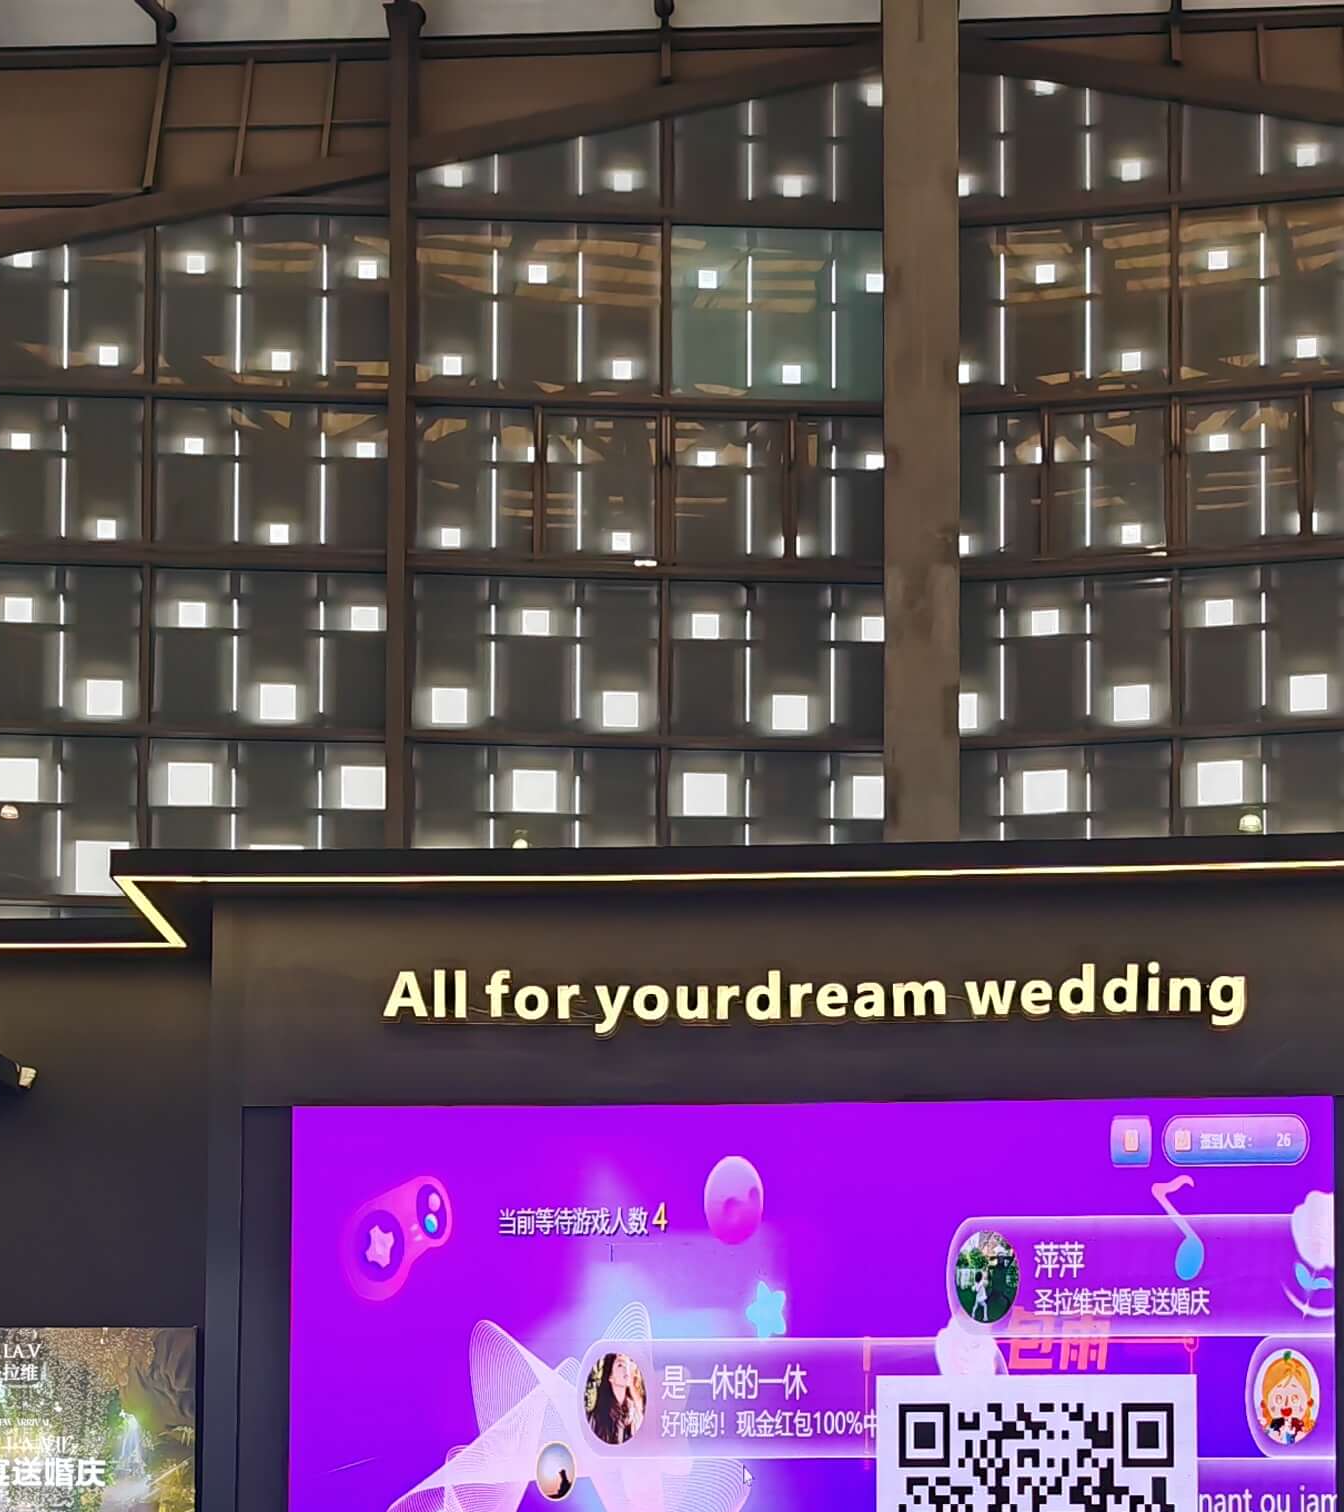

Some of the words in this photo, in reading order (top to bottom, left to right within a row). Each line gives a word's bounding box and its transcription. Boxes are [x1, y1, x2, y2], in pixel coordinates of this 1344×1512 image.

[383, 968, 467, 1018] All
[484, 969, 582, 1020] for
[965, 962, 1248, 1026] wedding
[1276, 1132, 1292, 1148] 26
[498, 1207, 649, 1235] 当前等待游戏人数
[651, 1202, 669, 1232] 4
[1033, 1242, 1086, 1279] 萍萍
[1033, 1287, 1211, 1316] 圣拉维定婚宴送婚庆
[661, 1363, 808, 1401] 是一休的一休
